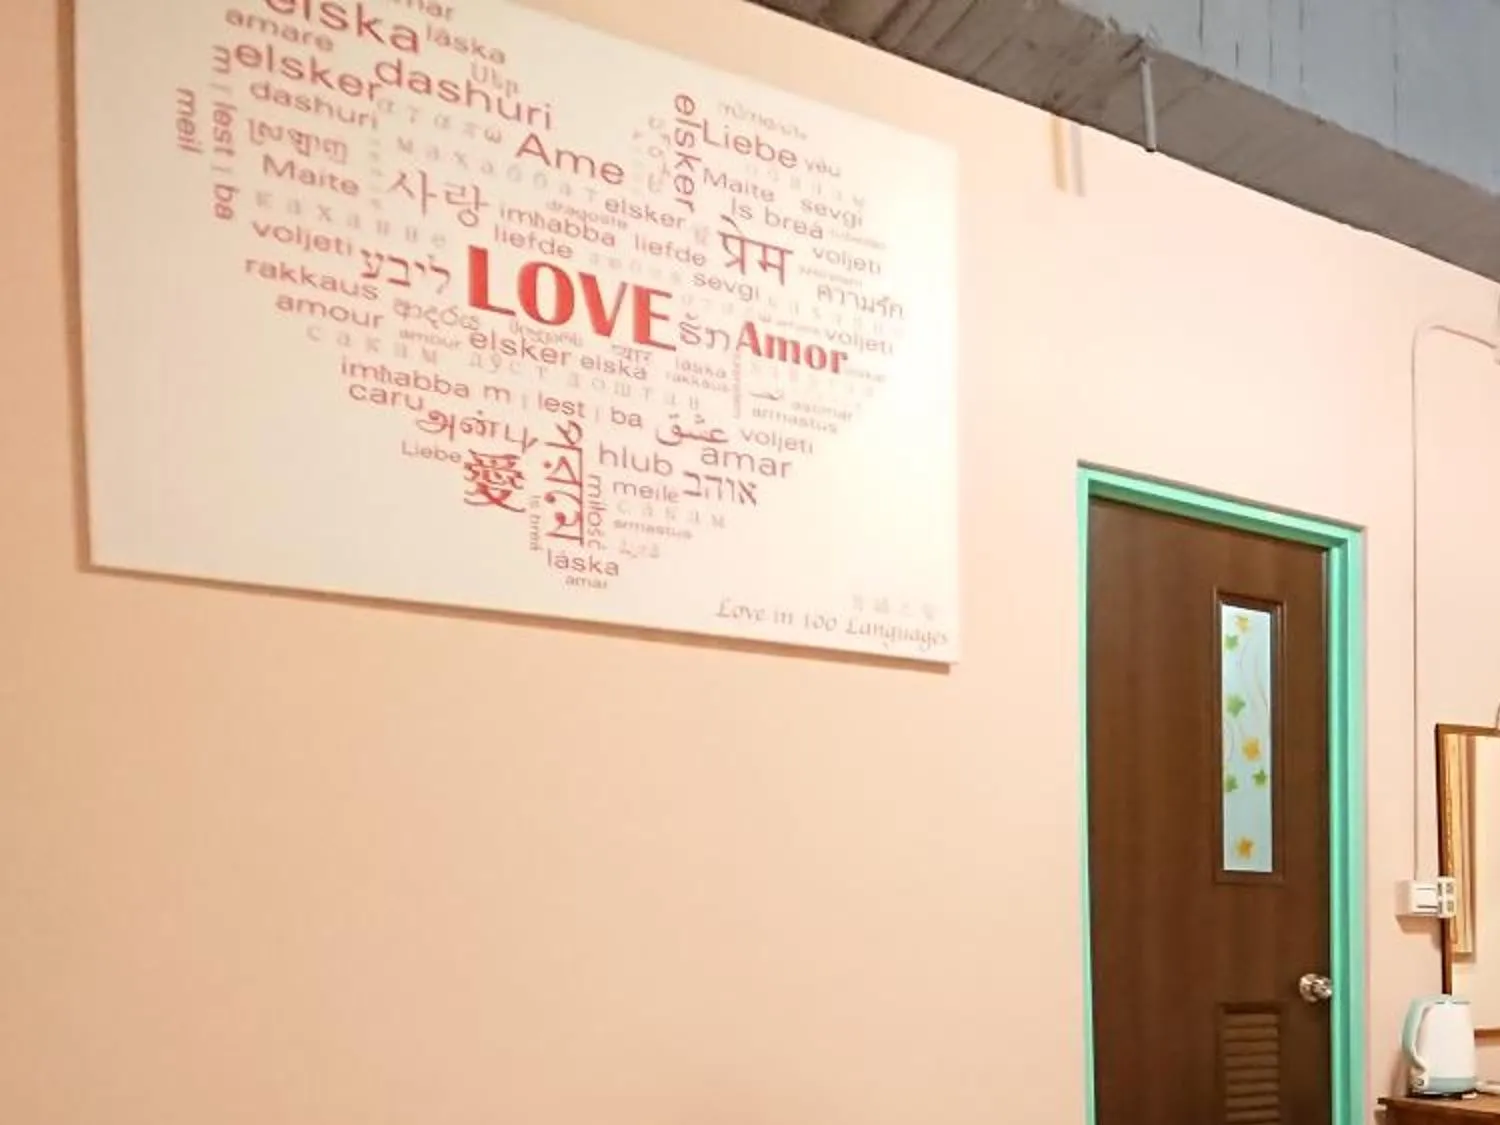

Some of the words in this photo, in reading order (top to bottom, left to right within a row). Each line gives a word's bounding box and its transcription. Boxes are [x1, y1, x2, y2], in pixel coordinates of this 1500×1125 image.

[224, 8, 335, 53] amare
[234, 44, 383, 103] elsker
[374, 57, 553, 131] dashuri
[249, 80, 379, 131] dashuri
[515, 131, 625, 186] Ame
[673, 92, 703, 214] elsker
[702, 117, 799, 170] Liebe
[261, 152, 360, 197] Maite
[702, 166, 776, 203] Maite
[387, 167, 490, 228] 사랑
[604, 197, 687, 231] elsker
[799, 198, 864, 229] sevgi
[251, 219, 353, 261] voljeti
[493, 223, 574, 260] liefde
[634, 233, 708, 268] liefde
[244, 257, 380, 302] rakkaus
[467, 243, 677, 353] LOVE
[692, 272, 760, 301] sevgi
[274, 293, 385, 330] amour
[469, 329, 573, 367] elsker
[580, 352, 649, 382] elska
[735, 319, 849, 375] Amor
[348, 383, 424, 413] caru
[400, 438, 463, 465] Liebe
[598, 440, 674, 477] hlub
[740, 426, 815, 455] voljeti
[462, 448, 527, 513] 愛
[701, 447, 794, 480] amar
[715, 593, 770, 623] Love
[772, 605, 795, 625] in
[803, 609, 838, 632] 100
[844, 614, 949, 652] Languages
